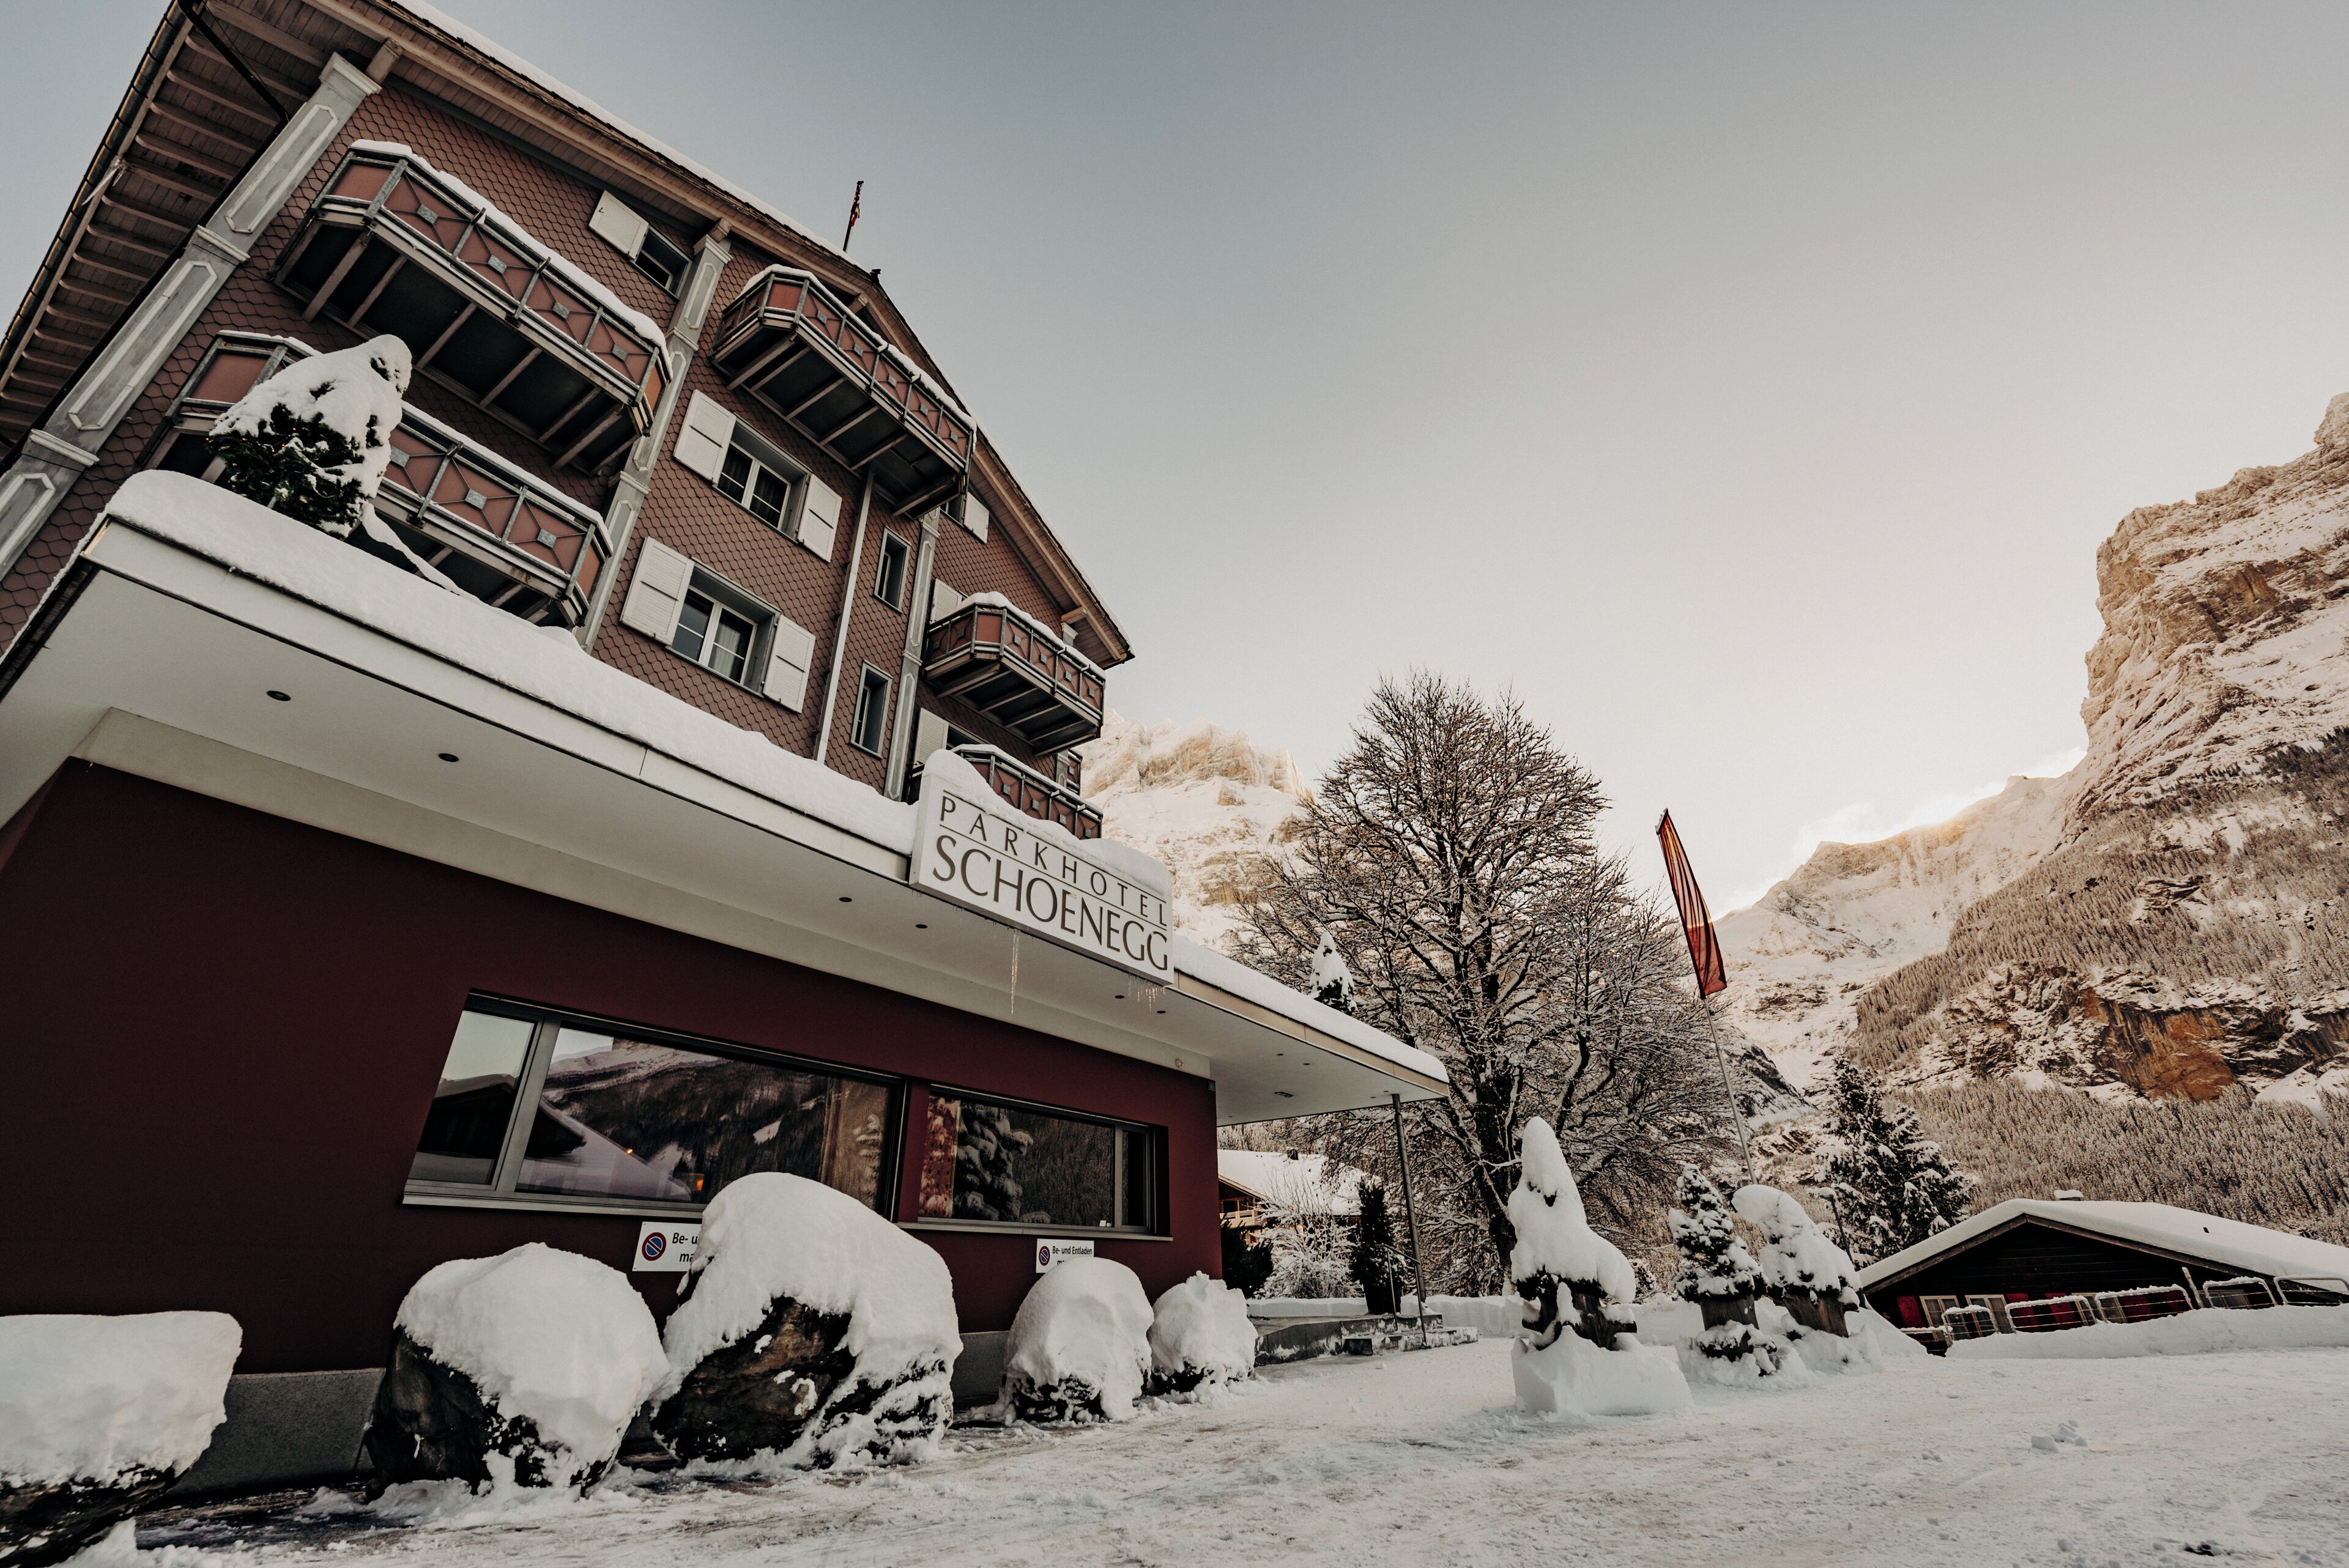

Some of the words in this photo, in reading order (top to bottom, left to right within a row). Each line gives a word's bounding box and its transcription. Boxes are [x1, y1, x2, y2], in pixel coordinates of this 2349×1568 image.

[940, 796, 1167, 927] PARKHOTEL
[932, 835, 1168, 971] SCHOENEGG
[672, 1232, 688, 1244] Be-
[691, 1235, 698, 1244] u
[1061, 1246, 1071, 1254] und
[1072, 1246, 1093, 1255] Entladen
